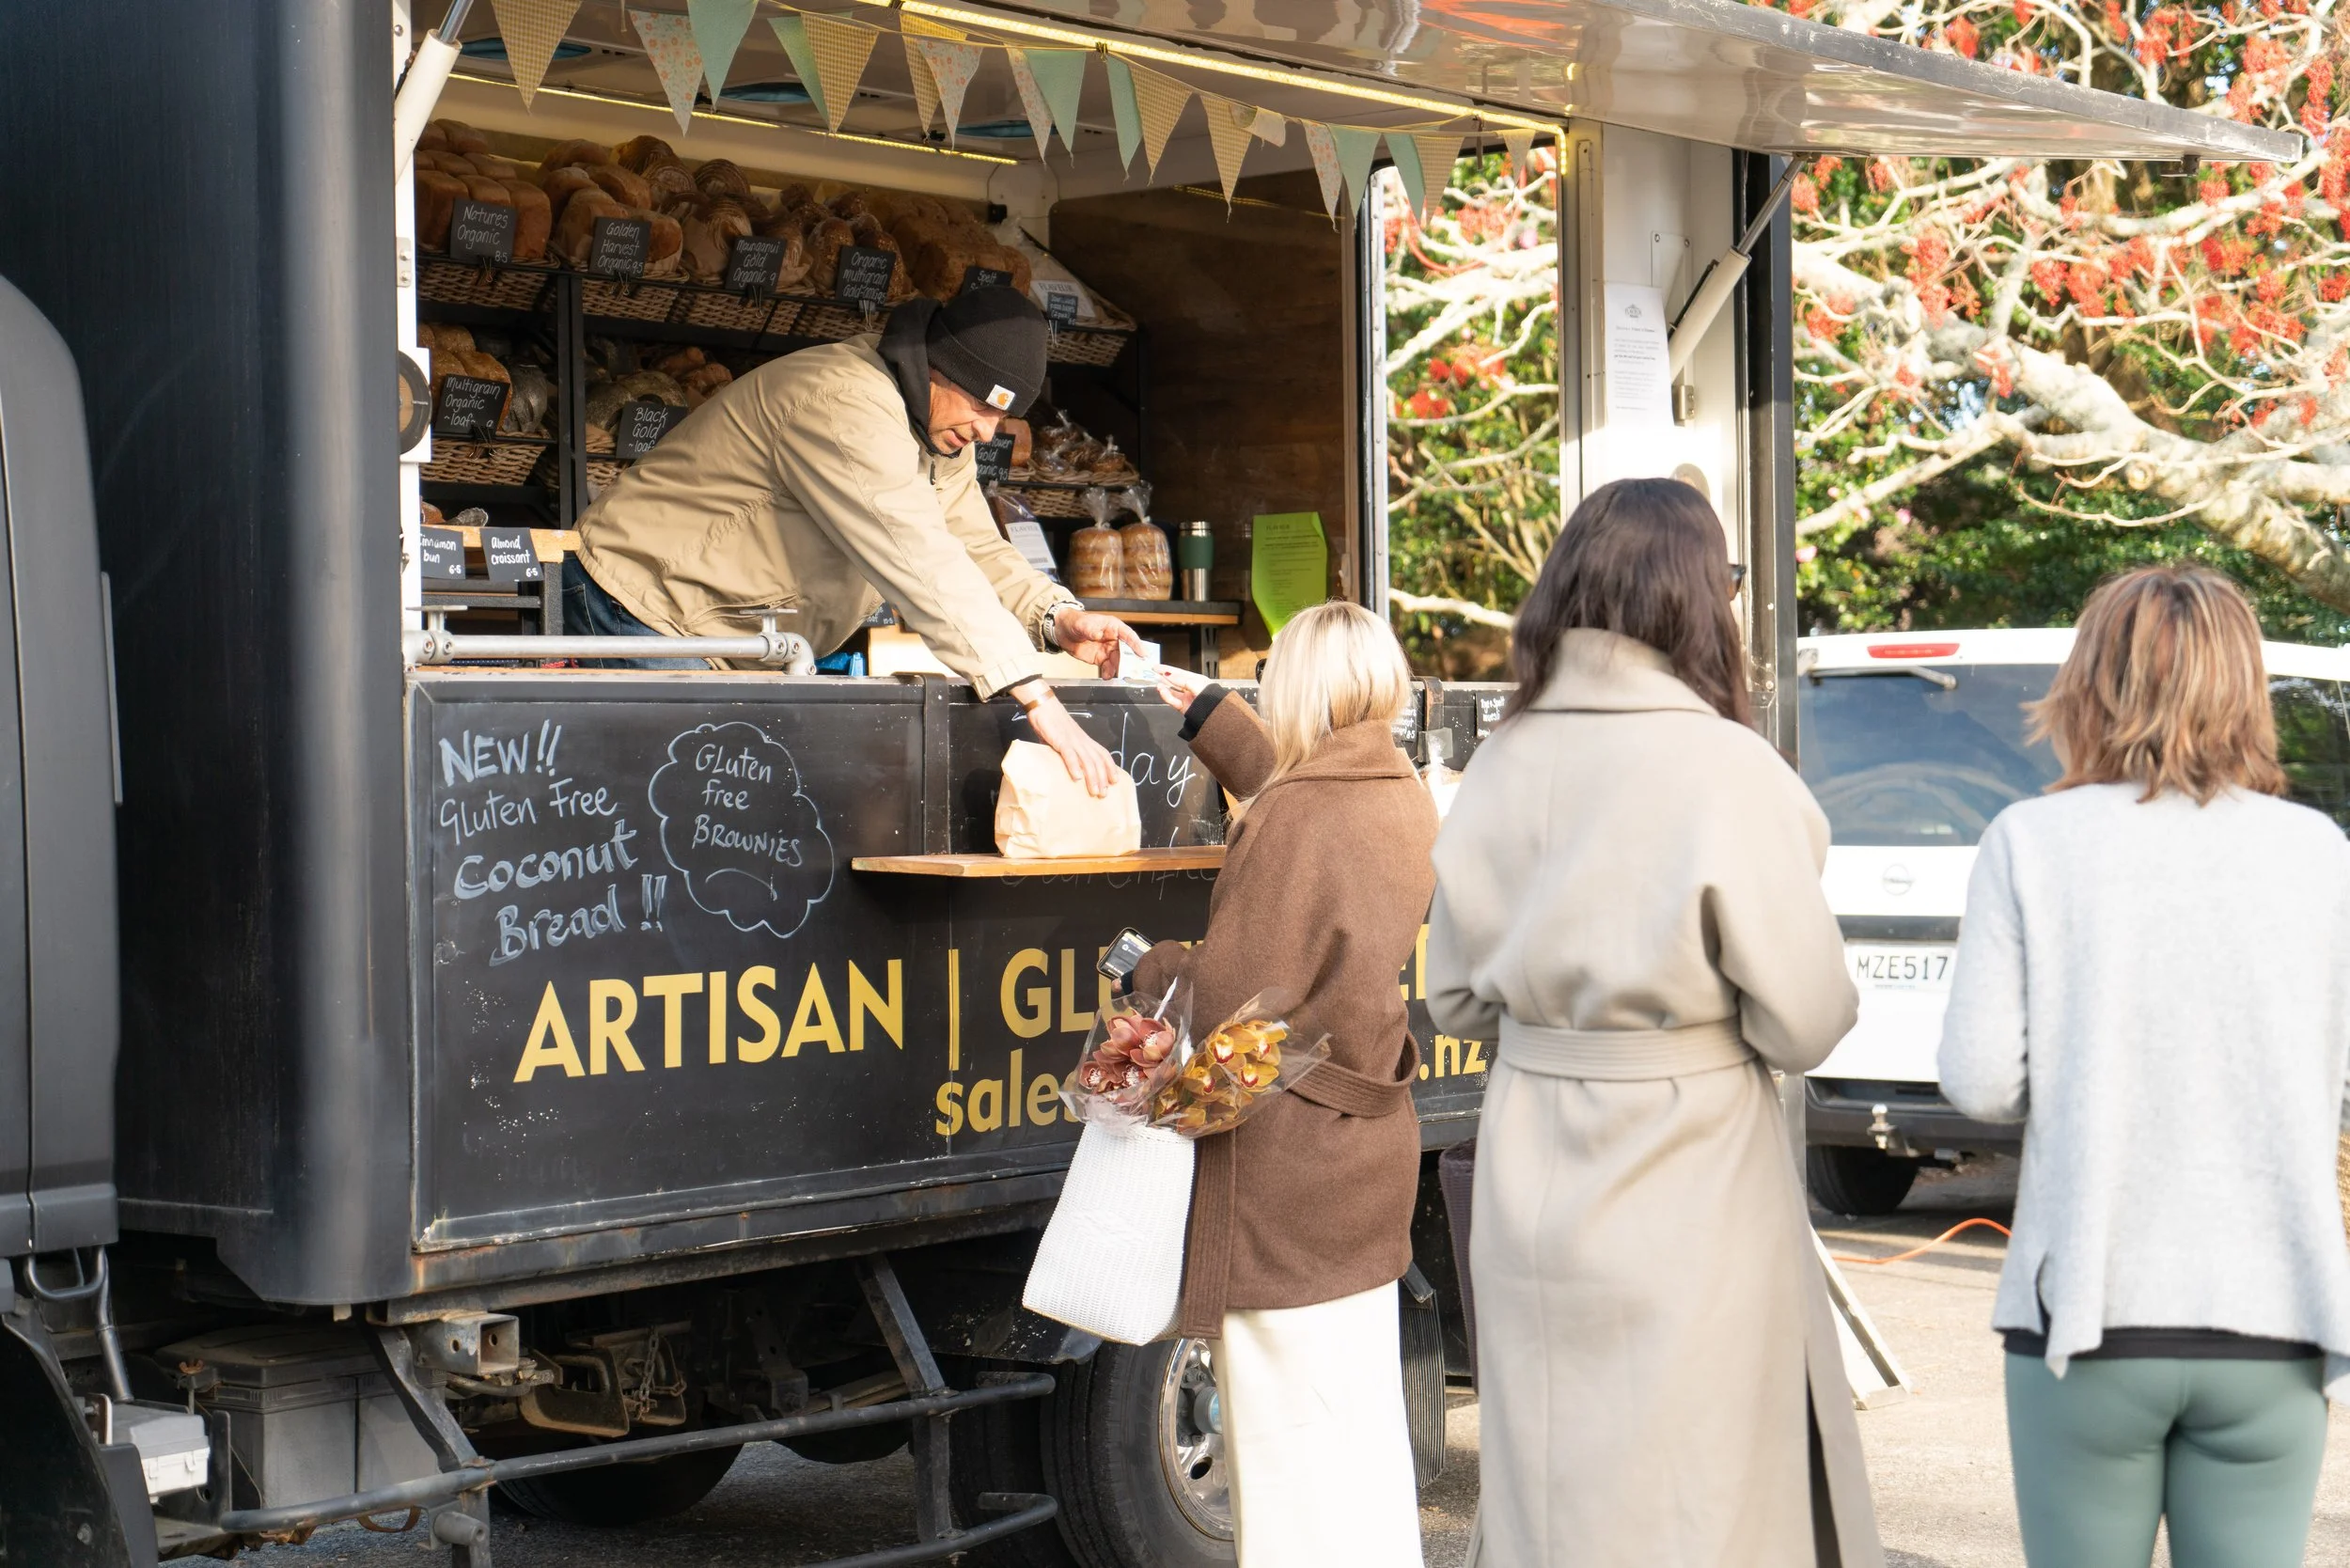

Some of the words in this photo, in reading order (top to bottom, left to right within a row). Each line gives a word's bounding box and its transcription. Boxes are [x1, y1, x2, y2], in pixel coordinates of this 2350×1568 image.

[462, 201, 509, 228] Nature's
[457, 224, 500, 250] Organic
[605, 222, 640, 242] Golden
[601, 239, 640, 257] Harvest
[597, 255, 632, 274] Organic
[743, 253, 768, 268] Gold
[851, 251, 887, 270] Organic
[732, 267, 767, 288] Organic
[445, 394, 485, 413] Organic
[634, 407, 668, 428] Black
[632, 423, 662, 439] Gold
[977, 447, 997, 463] Gold
[977, 463, 997, 478] ganic
[420, 533, 457, 551] innamon
[423, 549, 440, 564] bun
[491, 549, 531, 565] croissant
[440, 789, 536, 846] Gluten
[549, 777, 618, 819] Free
[453, 819, 638, 900] Coconut
[489, 884, 628, 967] Bread
[1856, 955, 1949, 980] MZE517
[512, 959, 903, 1084] ARTISAN
